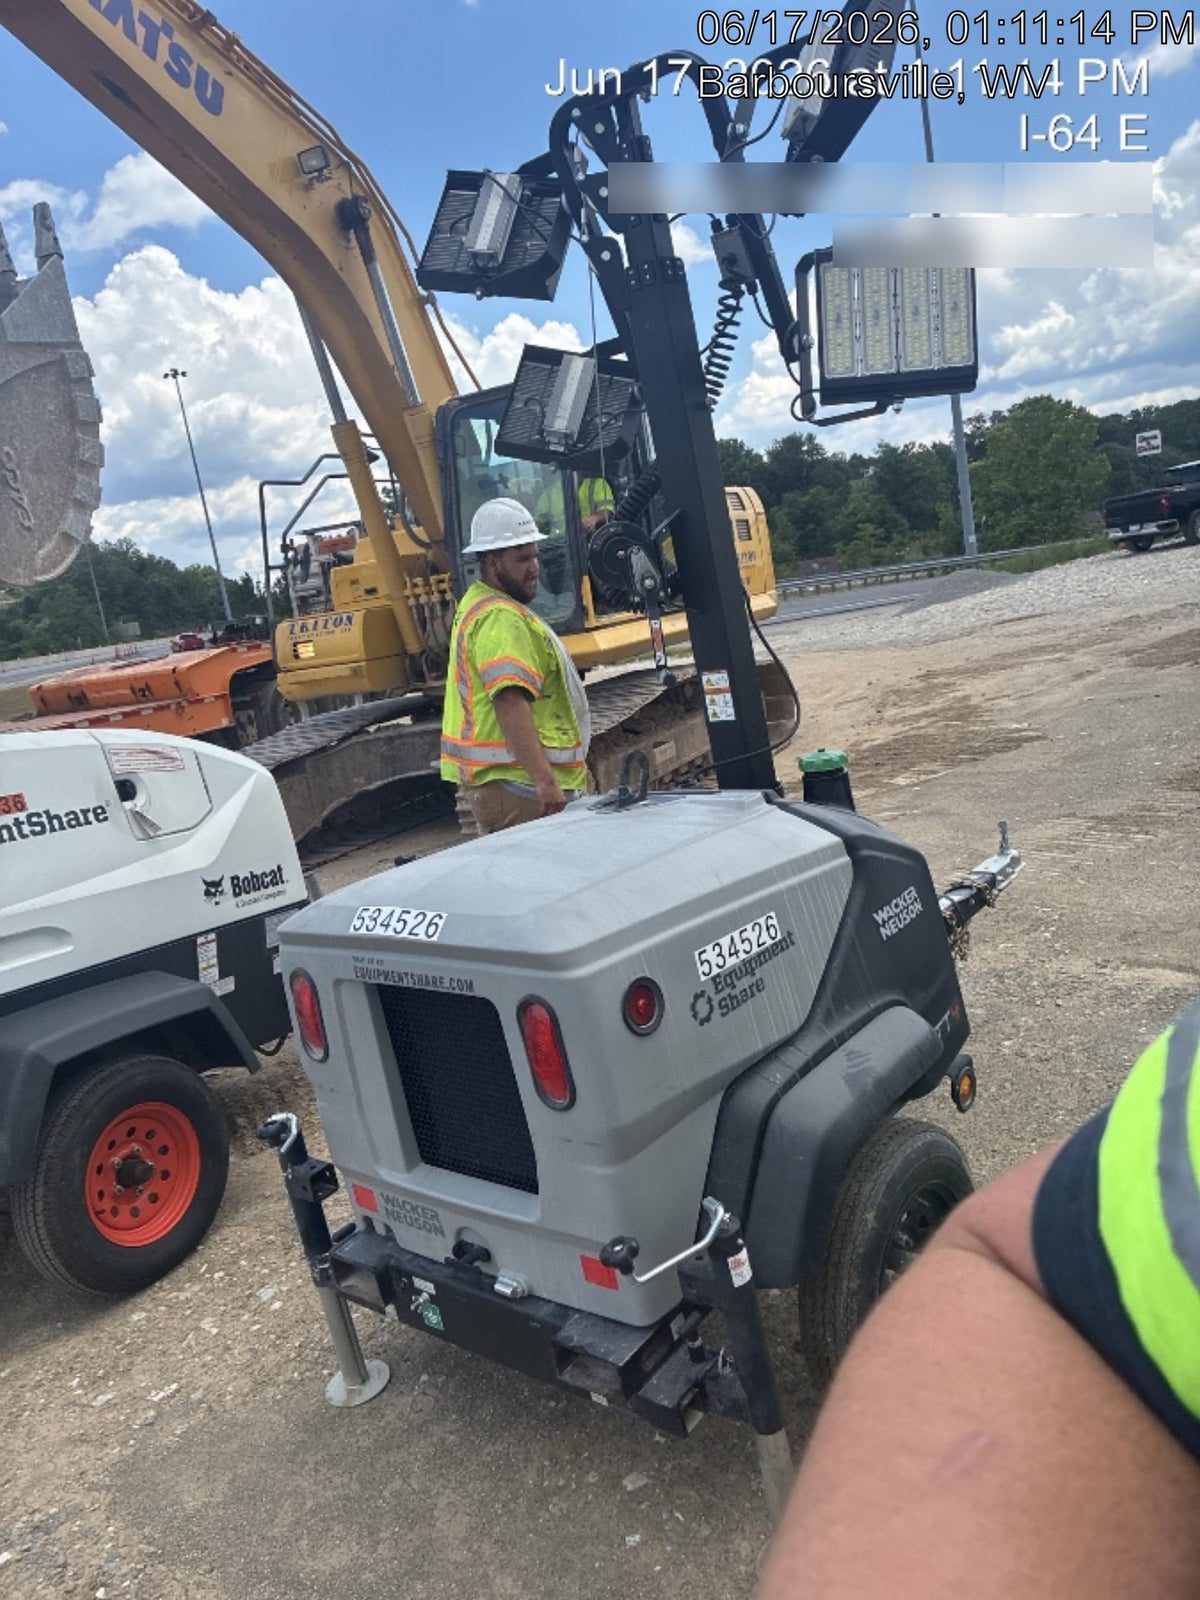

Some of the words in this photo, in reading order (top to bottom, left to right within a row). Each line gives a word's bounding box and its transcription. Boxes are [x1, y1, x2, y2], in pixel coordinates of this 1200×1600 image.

[88, 0, 224, 116] ATSU
[230, 864, 285, 898] Bobcat
[353, 907, 445, 939] 534526
[872, 886, 920, 925] WACKER
[880, 899, 924, 941] NEUSON
[698, 914, 778, 977] 534526
[711, 930, 796, 995] Equipment
[353, 965, 475, 993] EQUIPMENTSHARE.COM
[718, 977, 766, 1018] Share
[380, 1191, 441, 1224] WACKER
[384, 1206, 446, 1238] NEUSON
